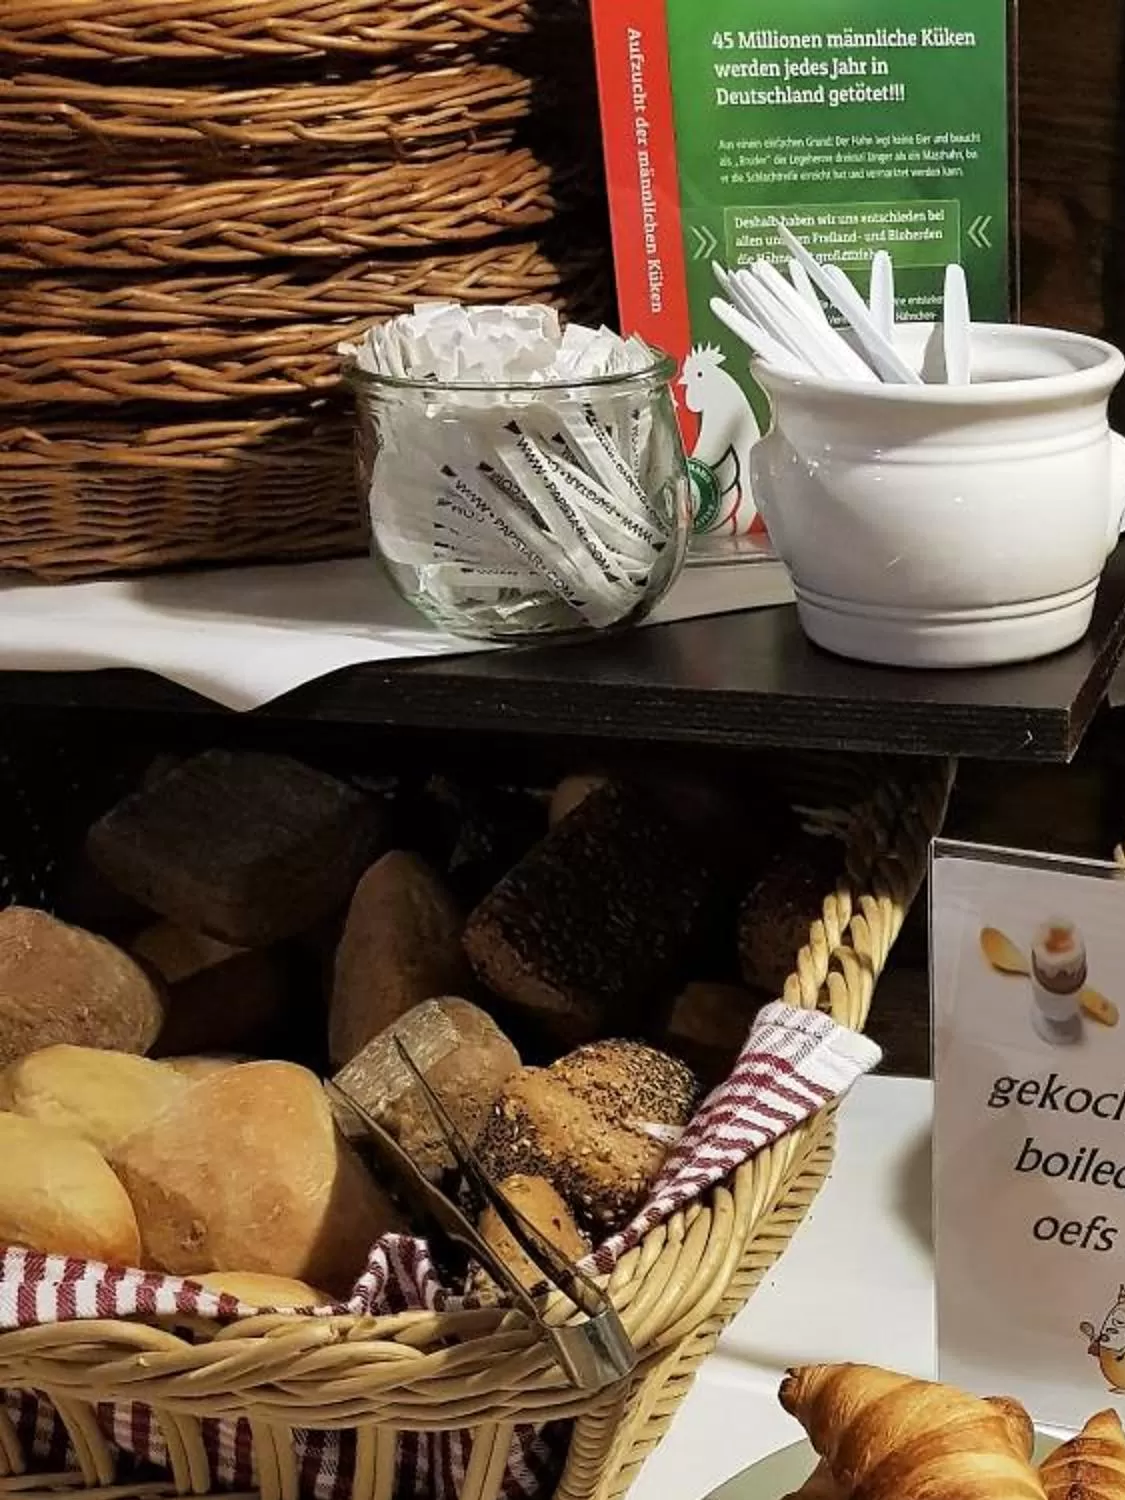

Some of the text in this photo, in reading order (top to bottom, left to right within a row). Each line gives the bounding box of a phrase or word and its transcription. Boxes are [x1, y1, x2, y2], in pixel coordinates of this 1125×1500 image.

[711, 26, 976, 49] 45 Millionen männliche Küken
[714, 56, 889, 80] werden jedes Jahr in
[716, 82, 905, 107] Deutschland getötet!!!
[626, 27, 665, 313] Aufzucht der männlichen Küken
[817, 212, 836, 226] wir
[927, 208, 945, 221] bei
[735, 234, 763, 248] allen
[864, 228, 886, 243] und
[1032, 1215, 1118, 1252] oefs
